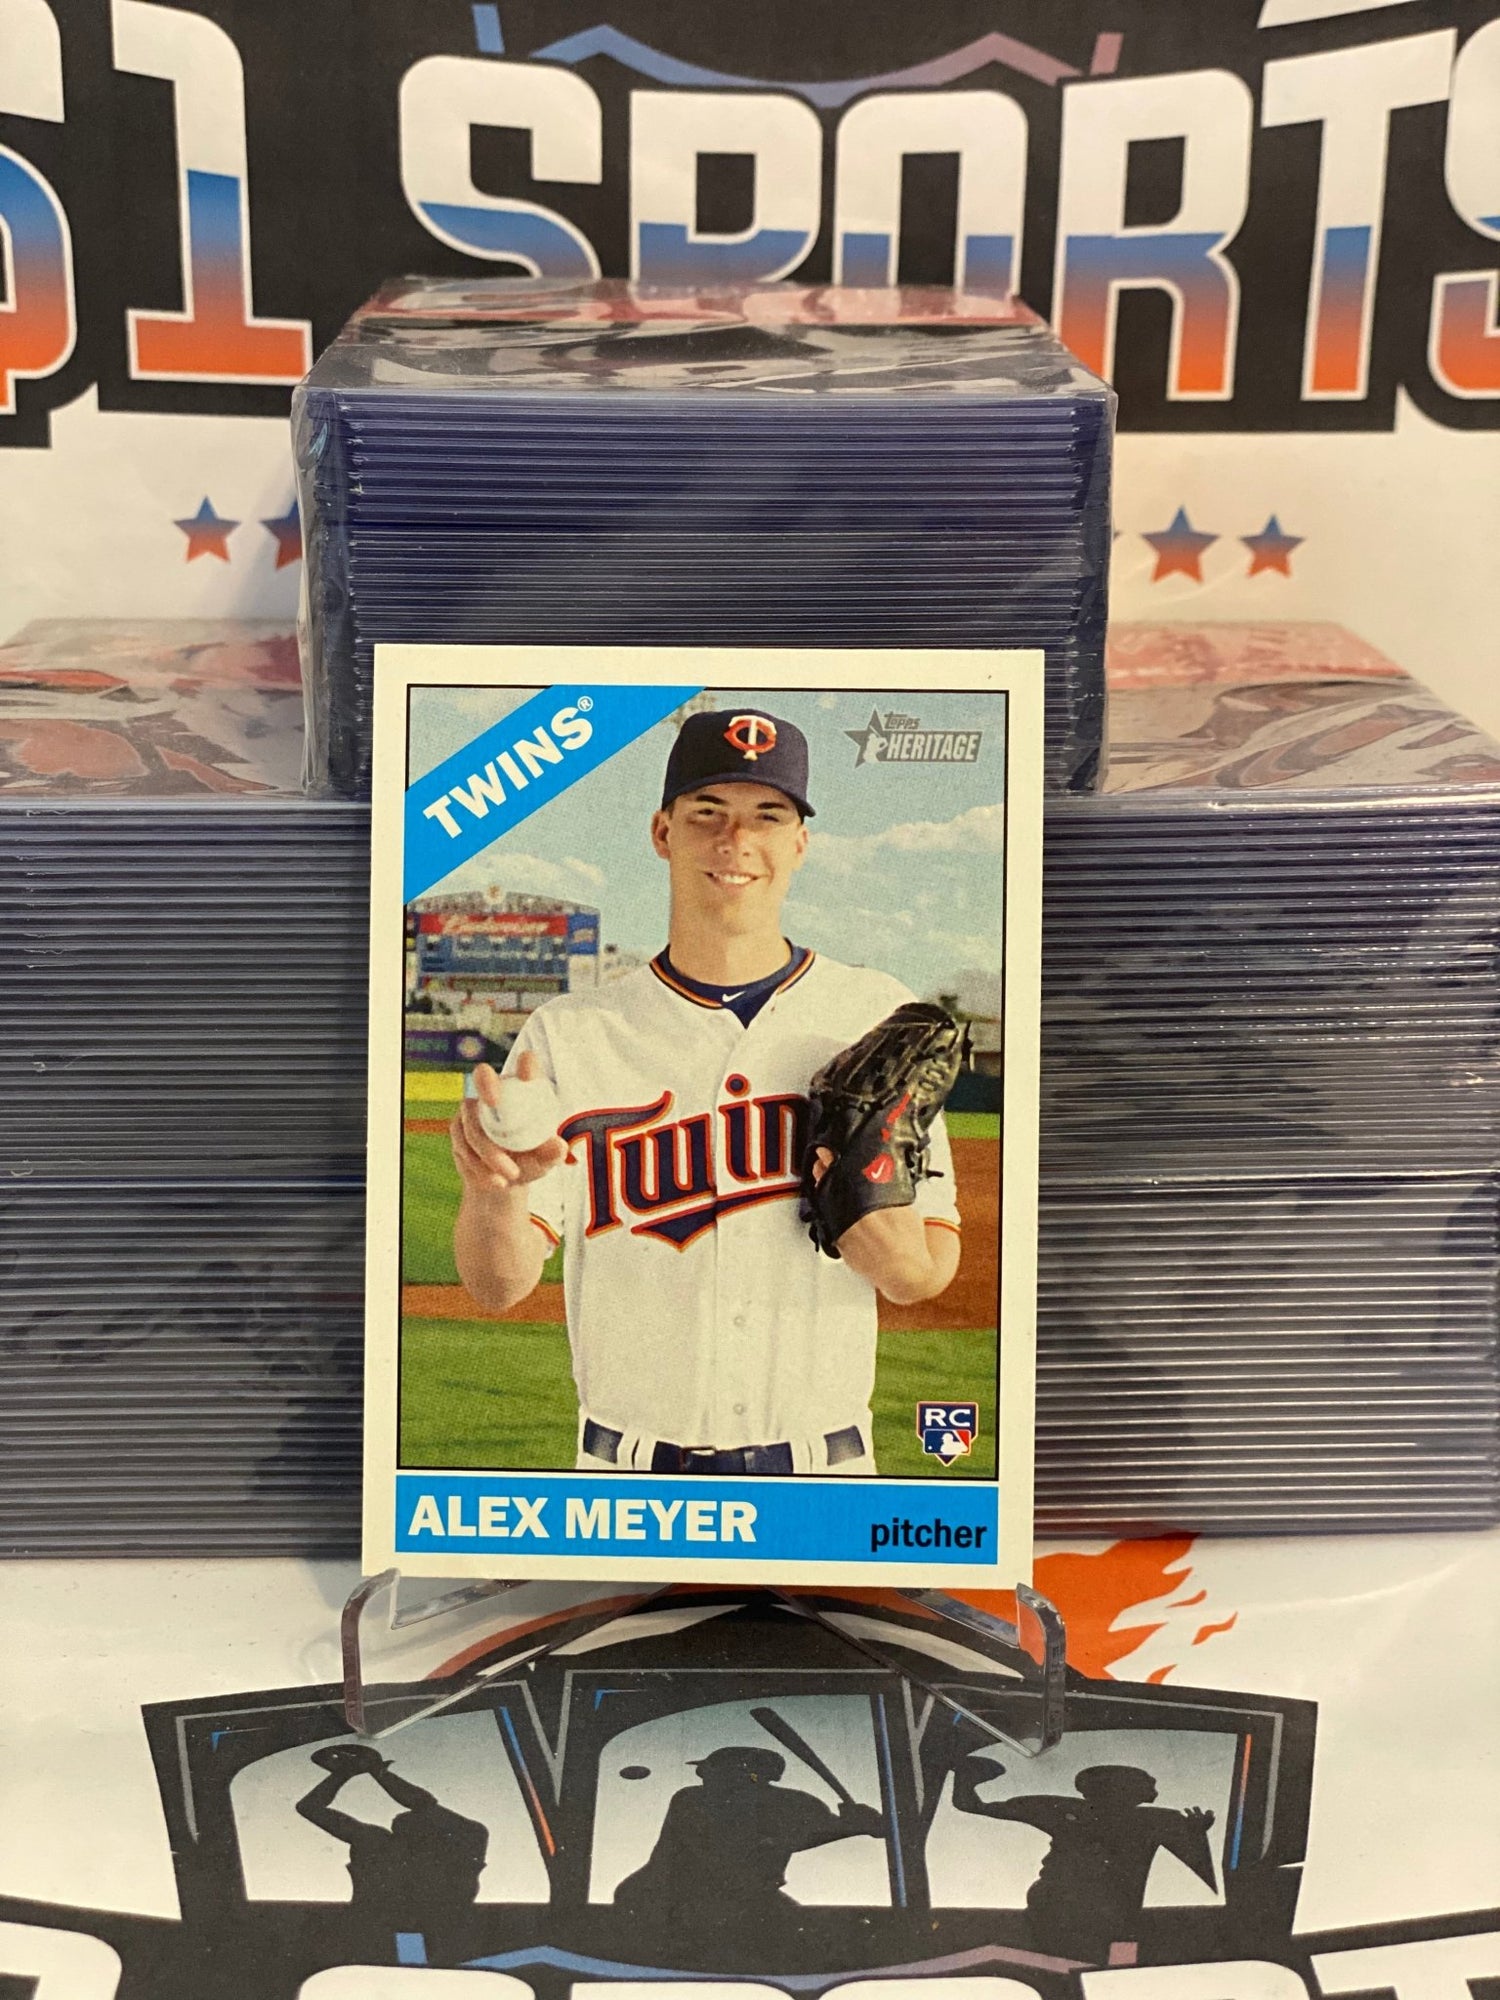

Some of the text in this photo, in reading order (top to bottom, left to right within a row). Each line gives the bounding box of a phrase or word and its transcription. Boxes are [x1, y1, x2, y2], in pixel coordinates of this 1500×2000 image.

[886, 733, 979, 760] HERITAGE
[925, 1408, 971, 1427] RC
[408, 1495, 758, 1543] ALEX MEYER
[871, 1517, 988, 1552] pitcher
